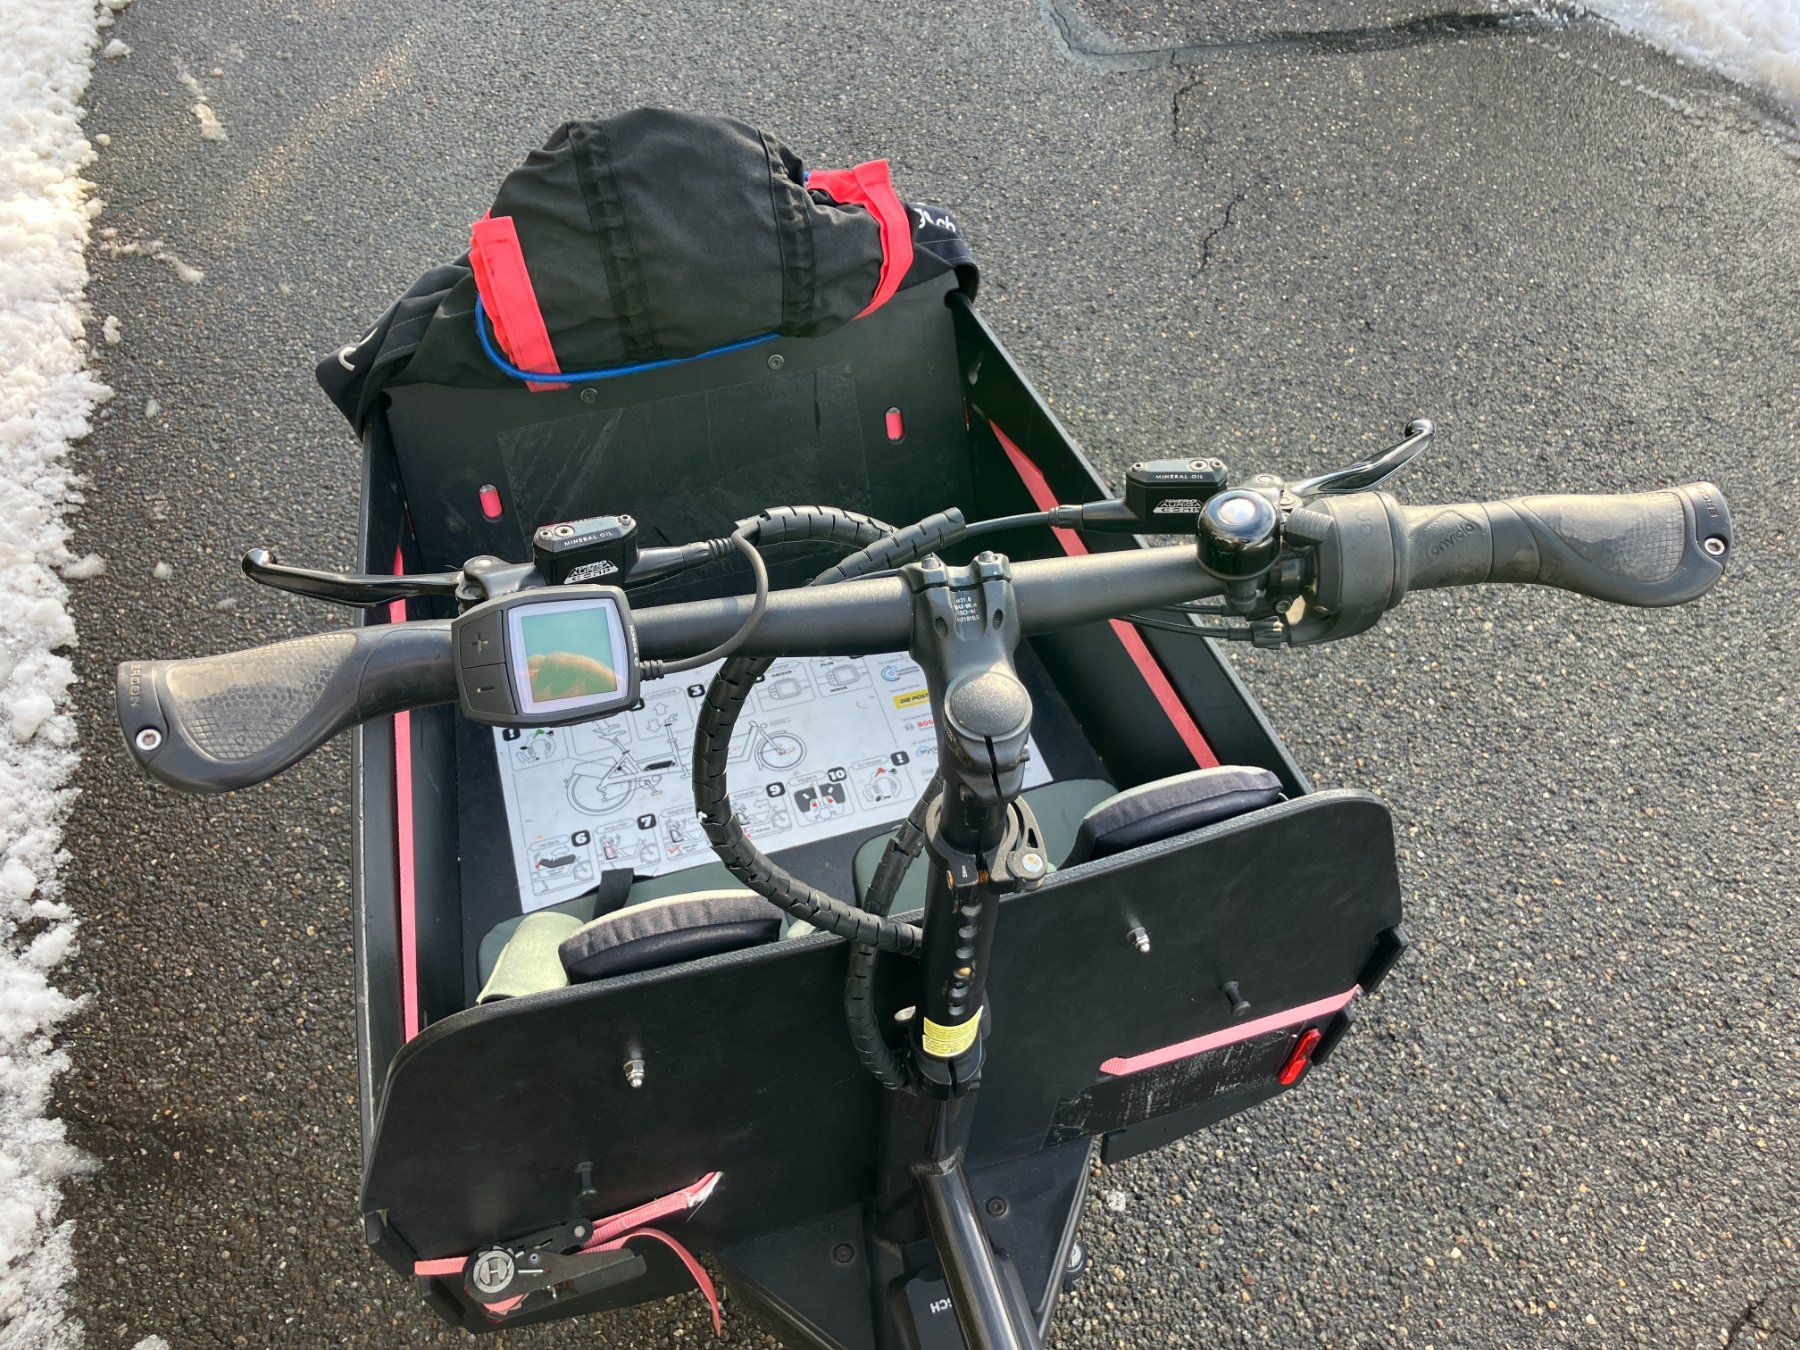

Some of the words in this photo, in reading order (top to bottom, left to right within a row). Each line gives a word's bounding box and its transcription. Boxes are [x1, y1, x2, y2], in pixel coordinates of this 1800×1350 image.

[563, 534, 598, 547] MINERAL
[599, 526, 614, 537] OIL
[690, 685, 702, 696] 3
[828, 768, 846, 781] 10
[769, 784, 781, 796] 9
[641, 815, 653, 828] 7
[575, 832, 588, 845] 6
